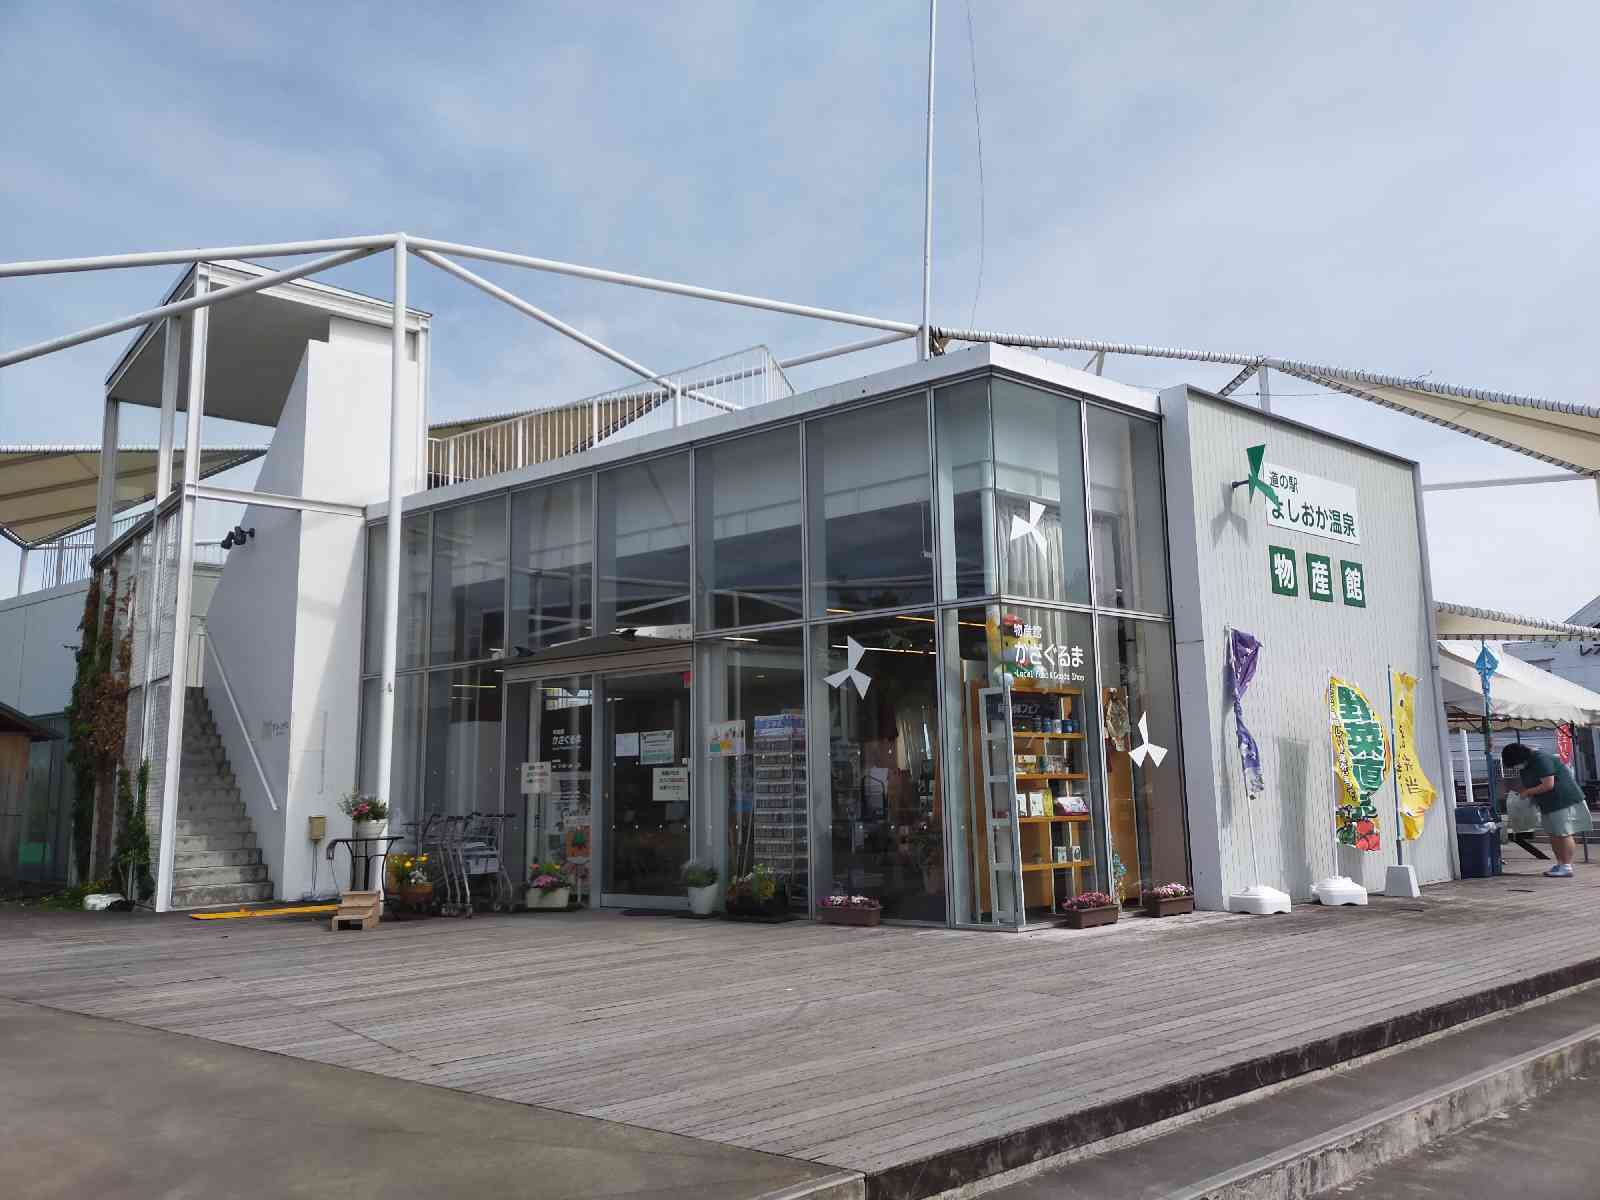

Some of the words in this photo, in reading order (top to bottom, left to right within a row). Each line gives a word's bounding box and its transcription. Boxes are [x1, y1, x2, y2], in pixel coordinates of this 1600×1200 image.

[1269, 471, 1298, 494] 道の駅
[1272, 499, 1357, 537] よしおか温泉
[1273, 553, 1363, 601] 物産館
[1013, 623, 1042, 638] 物産館
[1014, 641, 1084, 668] かざぐるま
